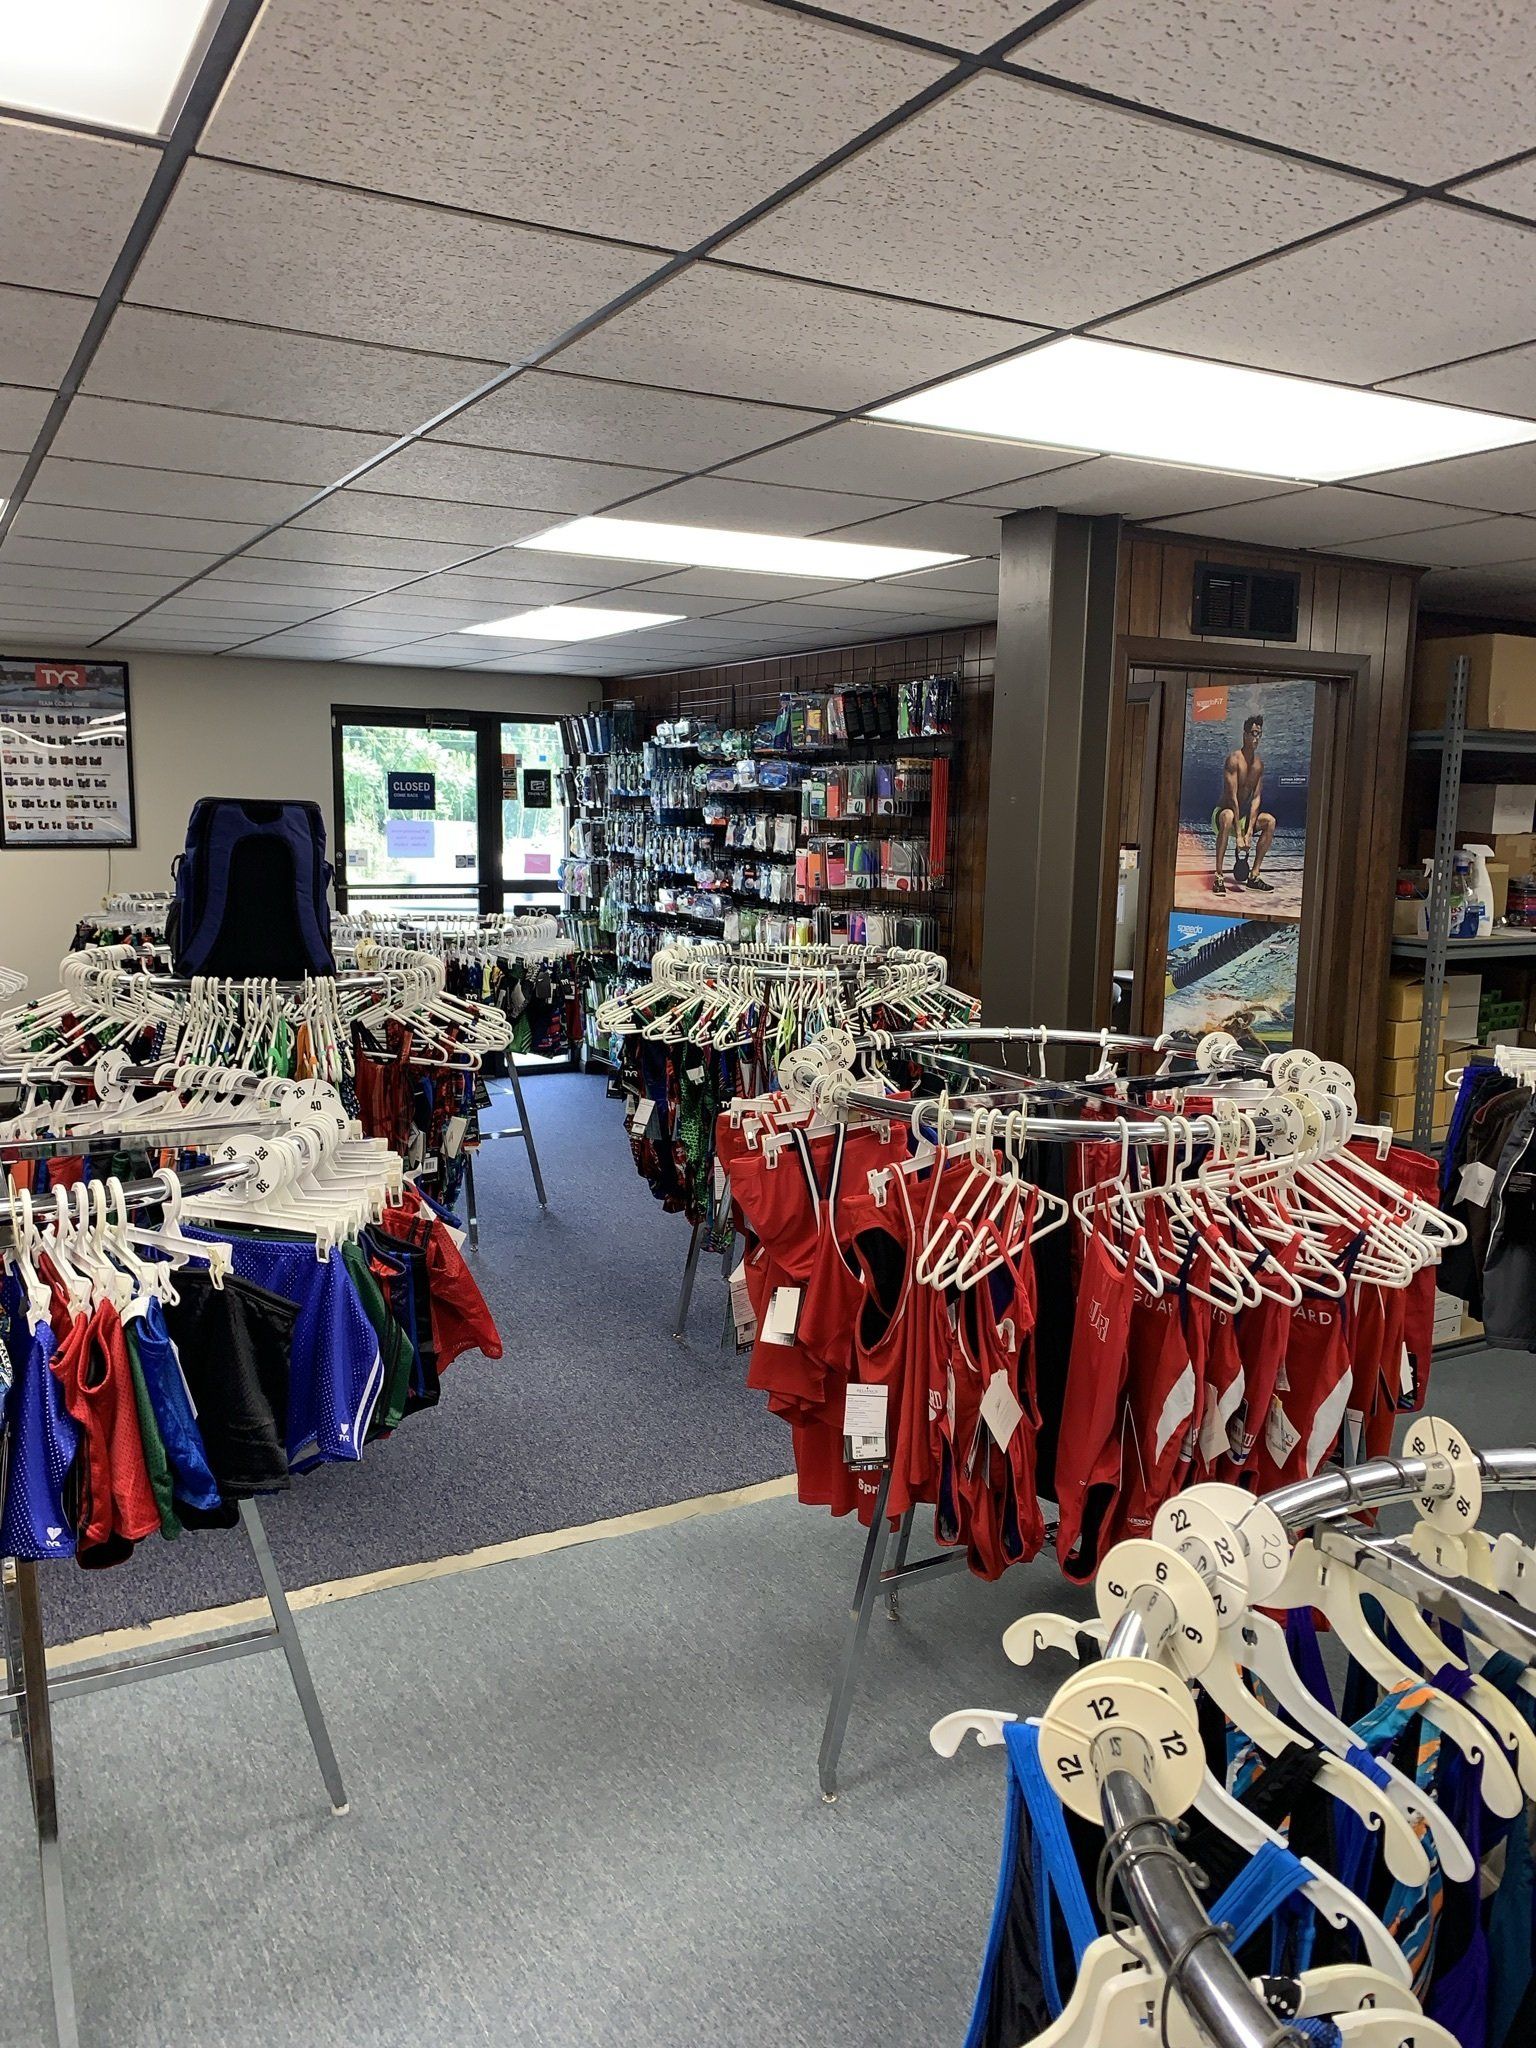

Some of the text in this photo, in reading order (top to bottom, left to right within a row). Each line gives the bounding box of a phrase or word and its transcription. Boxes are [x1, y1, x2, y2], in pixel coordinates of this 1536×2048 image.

[41, 669, 79, 685] TYR
[393, 781, 431, 791] CLOSED
[526, 907, 548, 917] TYR
[1177, 924, 1203, 934] speedo
[817, 1034, 829, 1045] XS
[839, 1035, 850, 1047] XS
[1204, 1038, 1219, 1055] LARGE
[100, 1060, 110, 1072] 28
[789, 1056, 797, 1065] S
[838, 1057, 849, 1069] XS
[624, 1069, 639, 1078] TYR
[1278, 1057, 1293, 1080] MEDIUM
[1319, 1066, 1327, 1076] S
[836, 1073, 843, 1083] M
[292, 1086, 306, 1099] 26
[1326, 1084, 1337, 1095] 40
[310, 1100, 322, 1112] 40
[720, 1101, 732, 1109] TY
[1281, 1104, 1294, 1118] 34
[1321, 1109, 1332, 1122] 38
[1286, 1131, 1298, 1146] 34
[223, 1146, 237, 1161] 38
[254, 1146, 269, 1161] 38
[255, 1179, 270, 1194] 38
[339, 1434, 350, 1442] TYR
[1412, 1437, 1426, 1456] 18
[1447, 1437, 1461, 1460] 18
[1456, 1496, 1471, 1517] 18
[1170, 1508, 1192, 1533] 22
[1214, 1537, 1235, 1567] 22
[1261, 1532, 1282, 1570] 20
[1155, 1562, 1169, 1585] 6
[1108, 1581, 1128, 1600] 6
[1181, 1624, 1203, 1645] 6
[1086, 1696, 1119, 1721] 12
[1159, 1730, 1188, 1760] 12
[1057, 1754, 1084, 1783] 12
